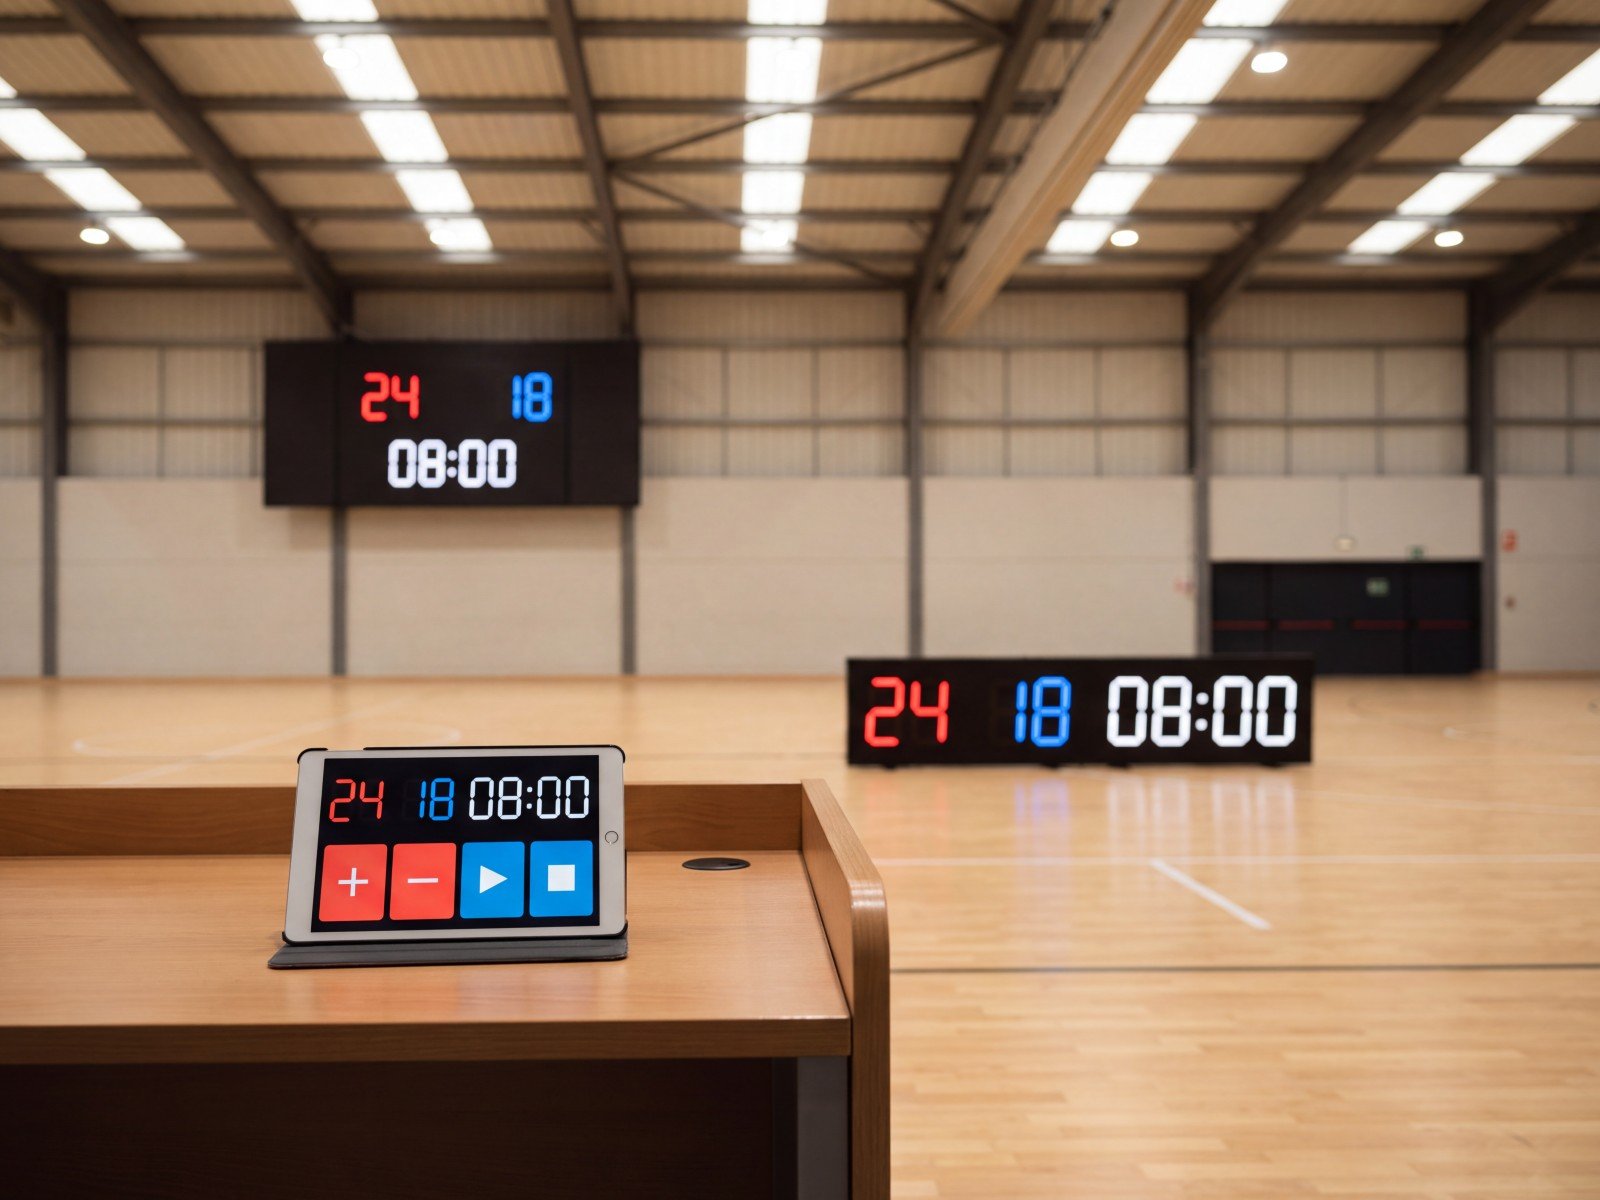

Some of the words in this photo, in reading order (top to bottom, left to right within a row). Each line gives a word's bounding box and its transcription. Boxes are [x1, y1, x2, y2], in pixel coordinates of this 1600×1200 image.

[360, 371, 420, 423] 24
[511, 371, 553, 423] 18
[387, 438, 518, 489] 08:00
[864, 676, 950, 748] 24
[1014, 676, 1072, 748] 18
[1106, 675, 1298, 748] 08:00
[328, 778, 385, 823] 24
[418, 777, 455, 821] 18
[468, 775, 590, 821] 08:00
